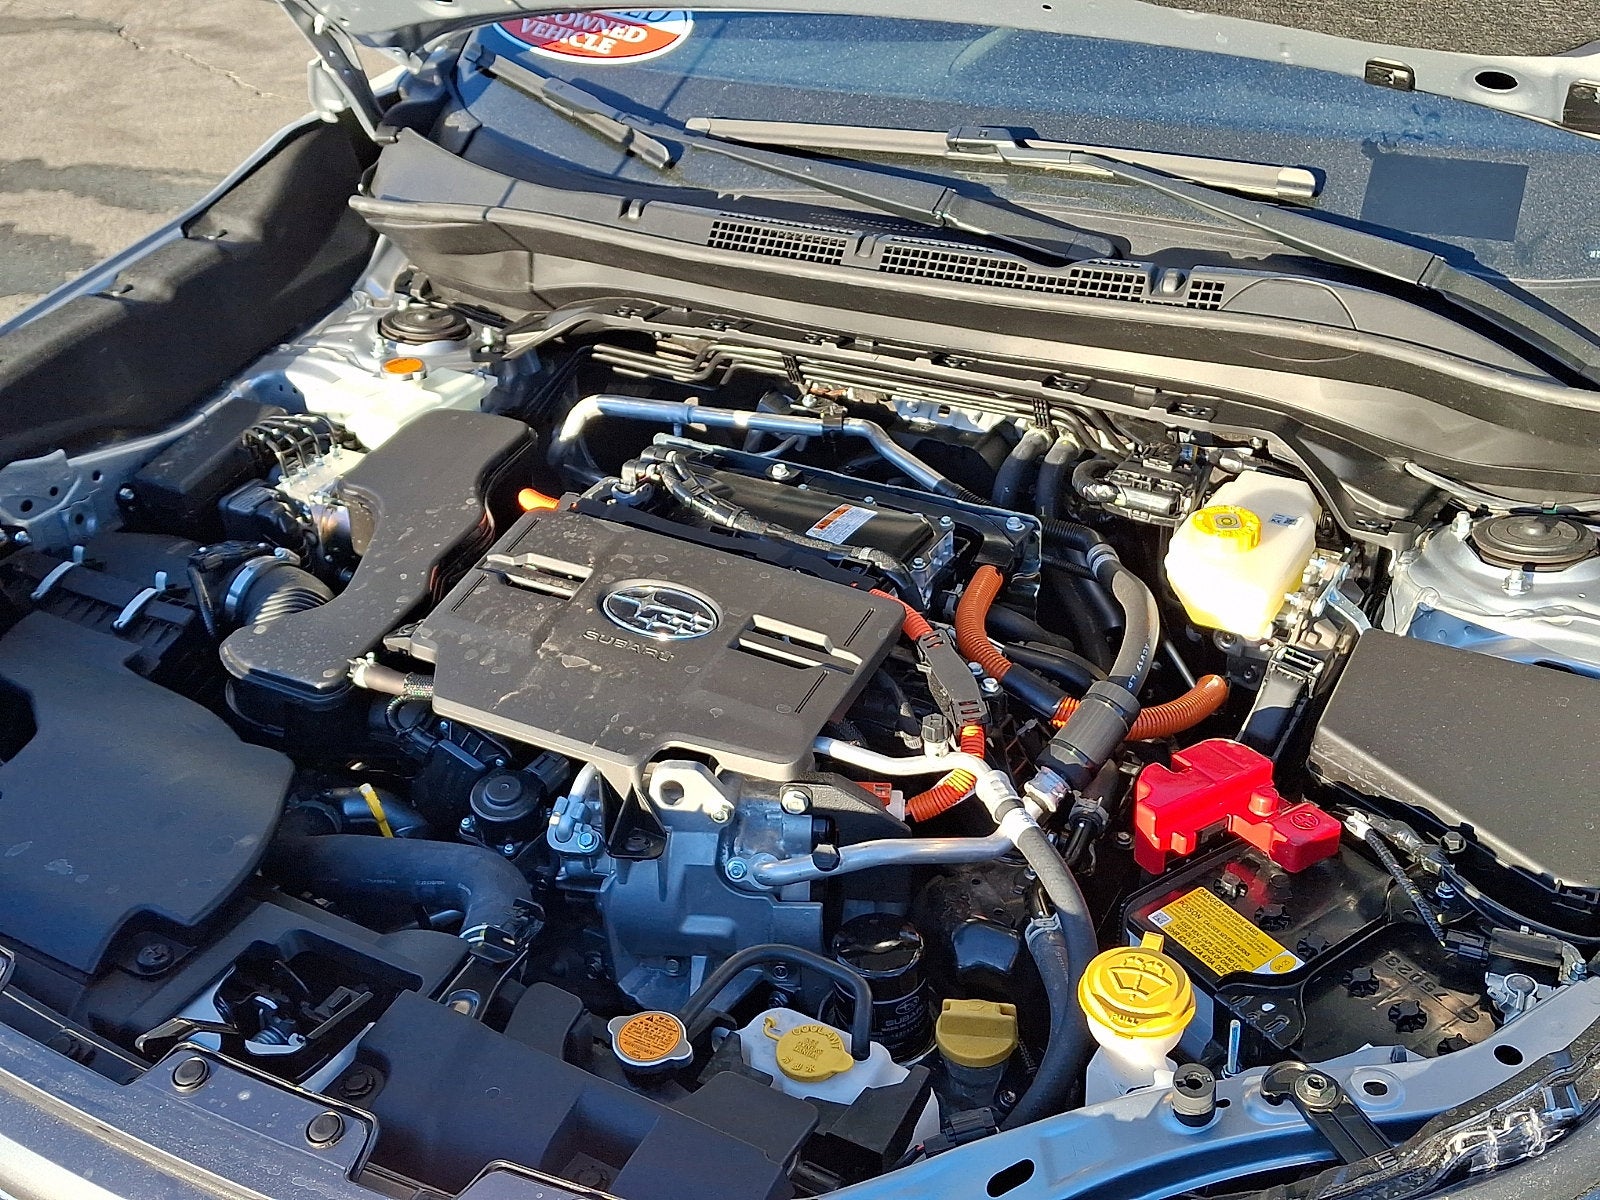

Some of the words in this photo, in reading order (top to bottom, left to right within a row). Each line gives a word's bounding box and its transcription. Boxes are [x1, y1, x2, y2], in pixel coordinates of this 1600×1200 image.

[520, 18, 616, 55] VEHICLE
[582, 629, 675, 662] SUBARU
[1178, 901, 1203, 919] POISON
[1197, 889, 1224, 908] DANGER
[1222, 908, 1246, 925] EXPLOSIVE
[1245, 925, 1260, 935] GASES
[1385, 955, 1450, 1002] 75023
[791, 1025, 841, 1051] COOLANT
